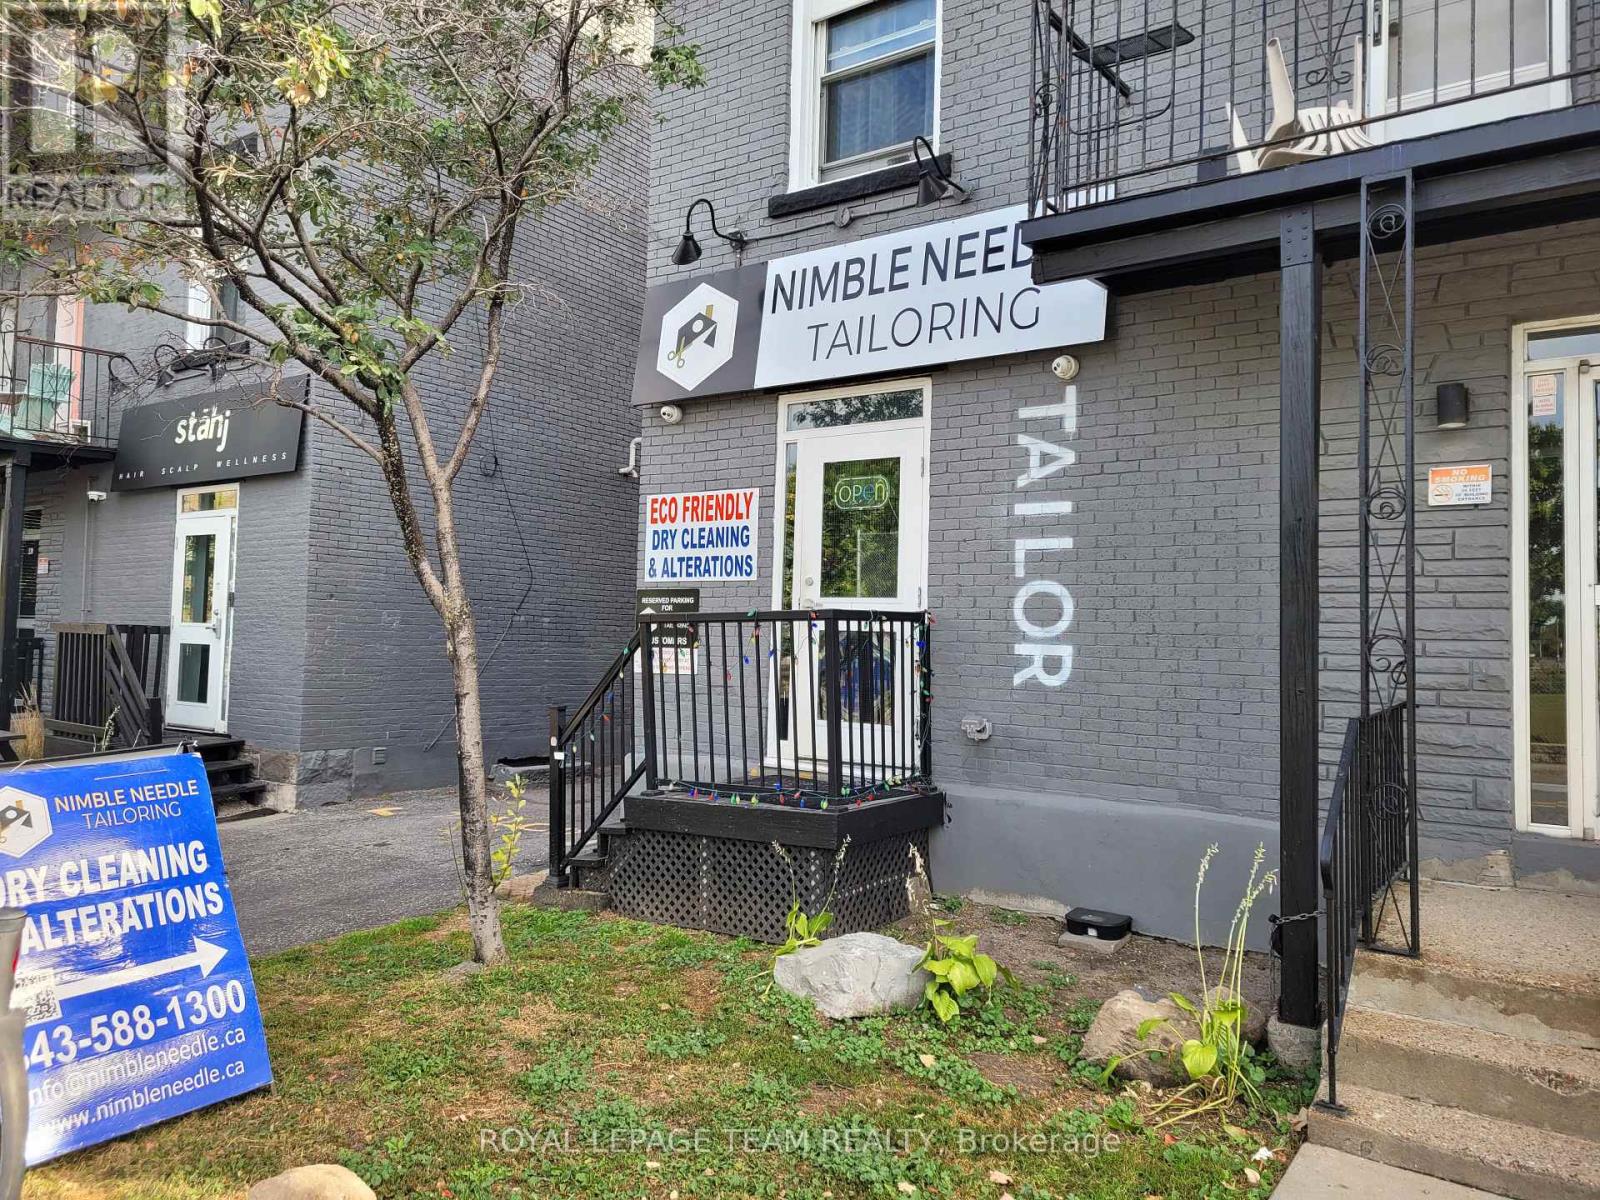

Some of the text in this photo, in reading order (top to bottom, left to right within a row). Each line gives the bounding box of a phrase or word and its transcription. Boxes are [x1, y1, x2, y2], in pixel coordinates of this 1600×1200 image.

[771, 245, 912, 314] NIMBLE
[807, 286, 1041, 361] TAILORING
[118, 452, 287, 480] HAIR SCALP WELLNESS
[1434, 475, 1489, 483] SMOKING
[1452, 468, 1468, 476] NO
[650, 492, 753, 524] ECO FRIENDLY
[652, 525, 750, 550] DRY CLEANING
[1013, 385, 1077, 687] TAILOR
[648, 555, 753, 578] & ALTERATIONS
[54, 780, 199, 813] NIMBLE NEEDLE
[82, 801, 182, 830] TAILORING
[59, 840, 208, 897] CLEANING
[21, 881, 224, 955] ALTERATIONS
[25, 979, 246, 1071] 43-588-1300
[28, 1026, 246, 1106] nfo@nimbleneedle.ca
